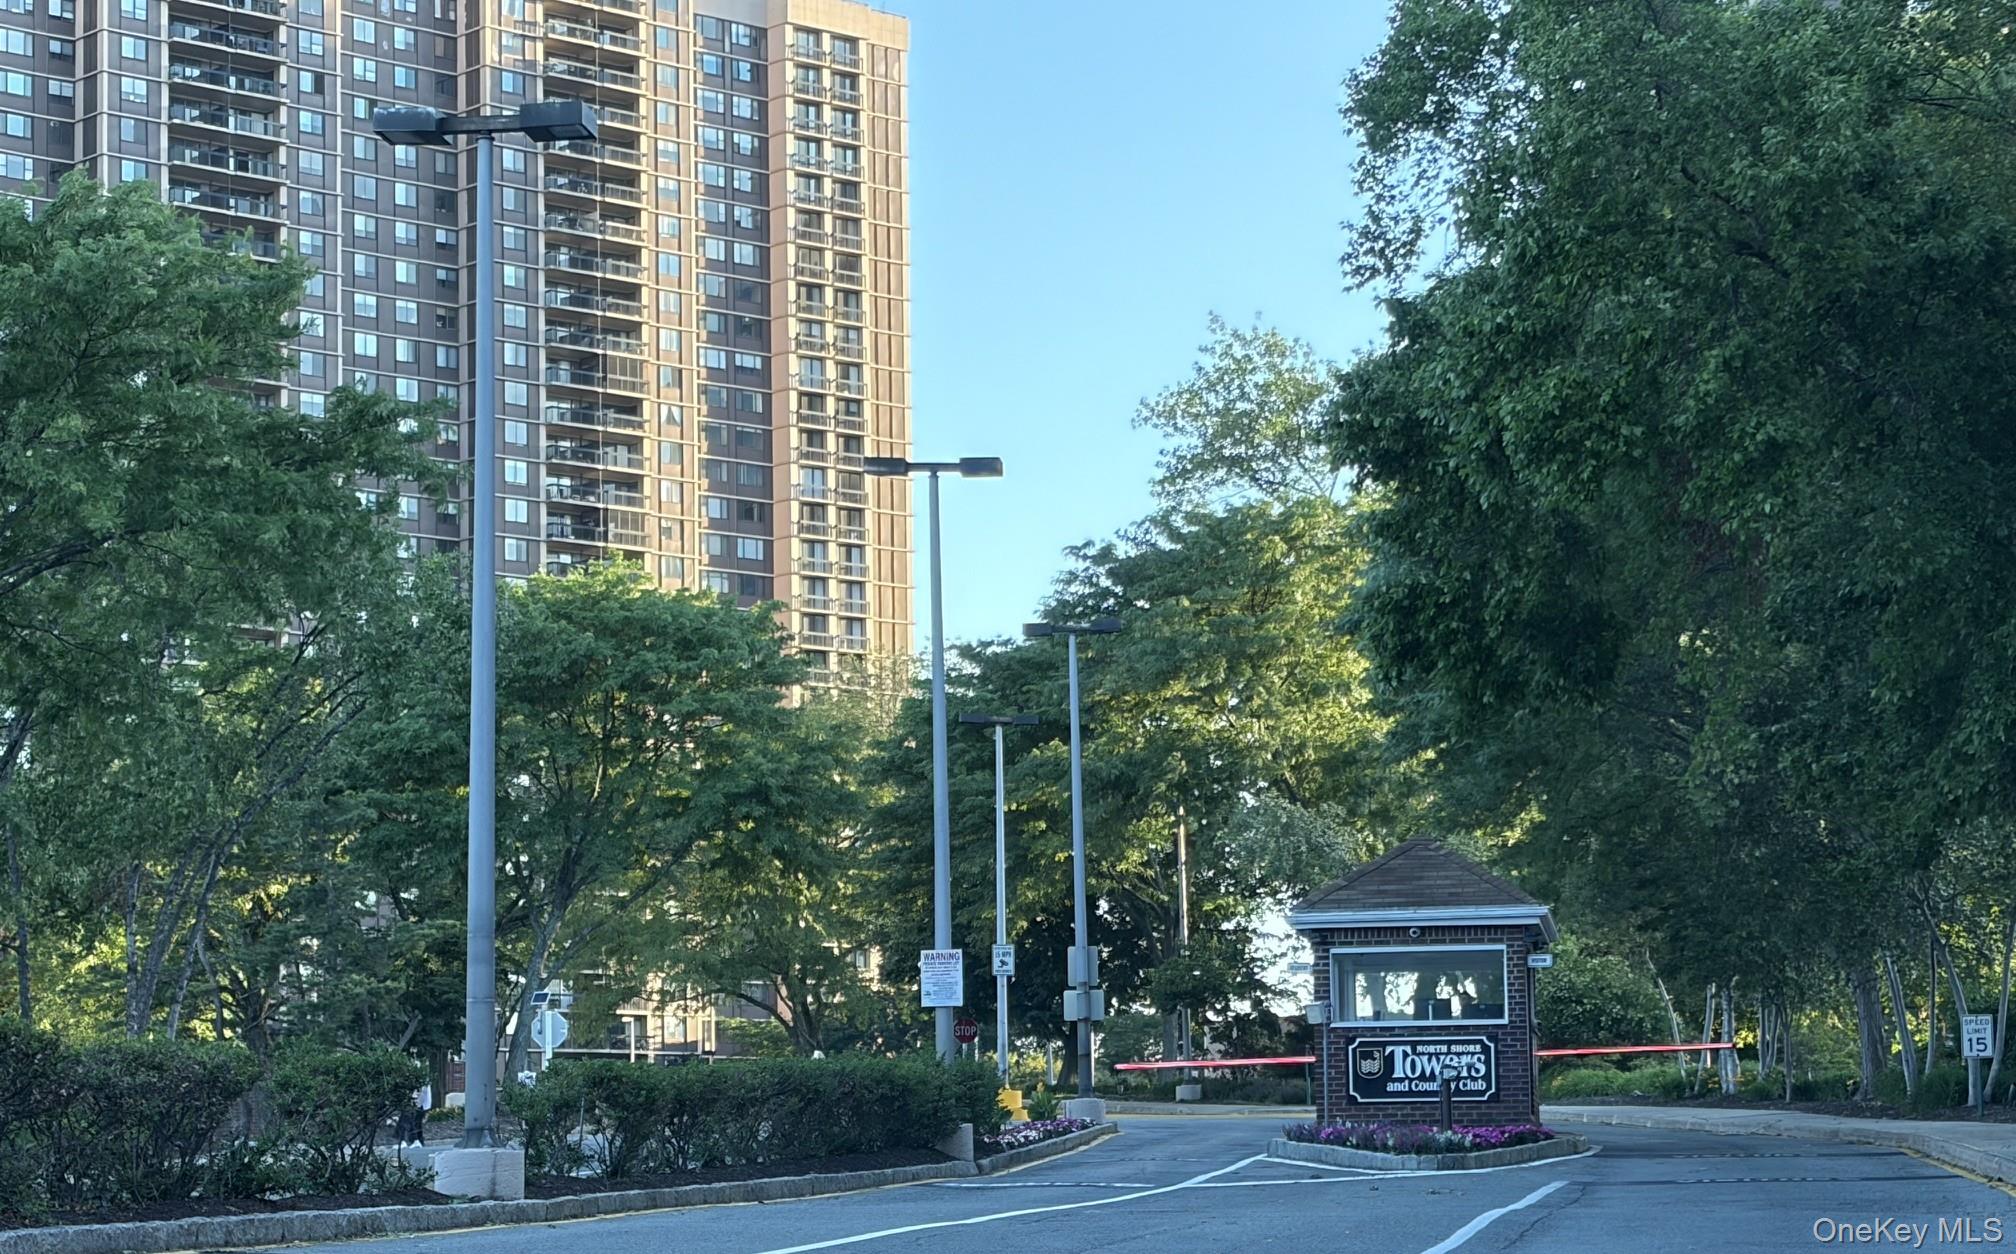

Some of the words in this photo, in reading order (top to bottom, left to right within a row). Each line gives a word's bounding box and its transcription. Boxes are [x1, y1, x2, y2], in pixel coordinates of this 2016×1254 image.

[923, 951, 960, 962] WARNING
[1964, 1018, 1990, 1026] SPEED
[954, 1025, 977, 1036] STOP
[1416, 1045, 1447, 1053] NORTH
[1450, 1044, 1482, 1053] SHORE
[1967, 1037, 1988, 1053] 15
[1386, 1079, 1409, 1092] and
[1411, 1080, 1457, 1093] Couny
[1459, 1079, 1487, 1091] Club
